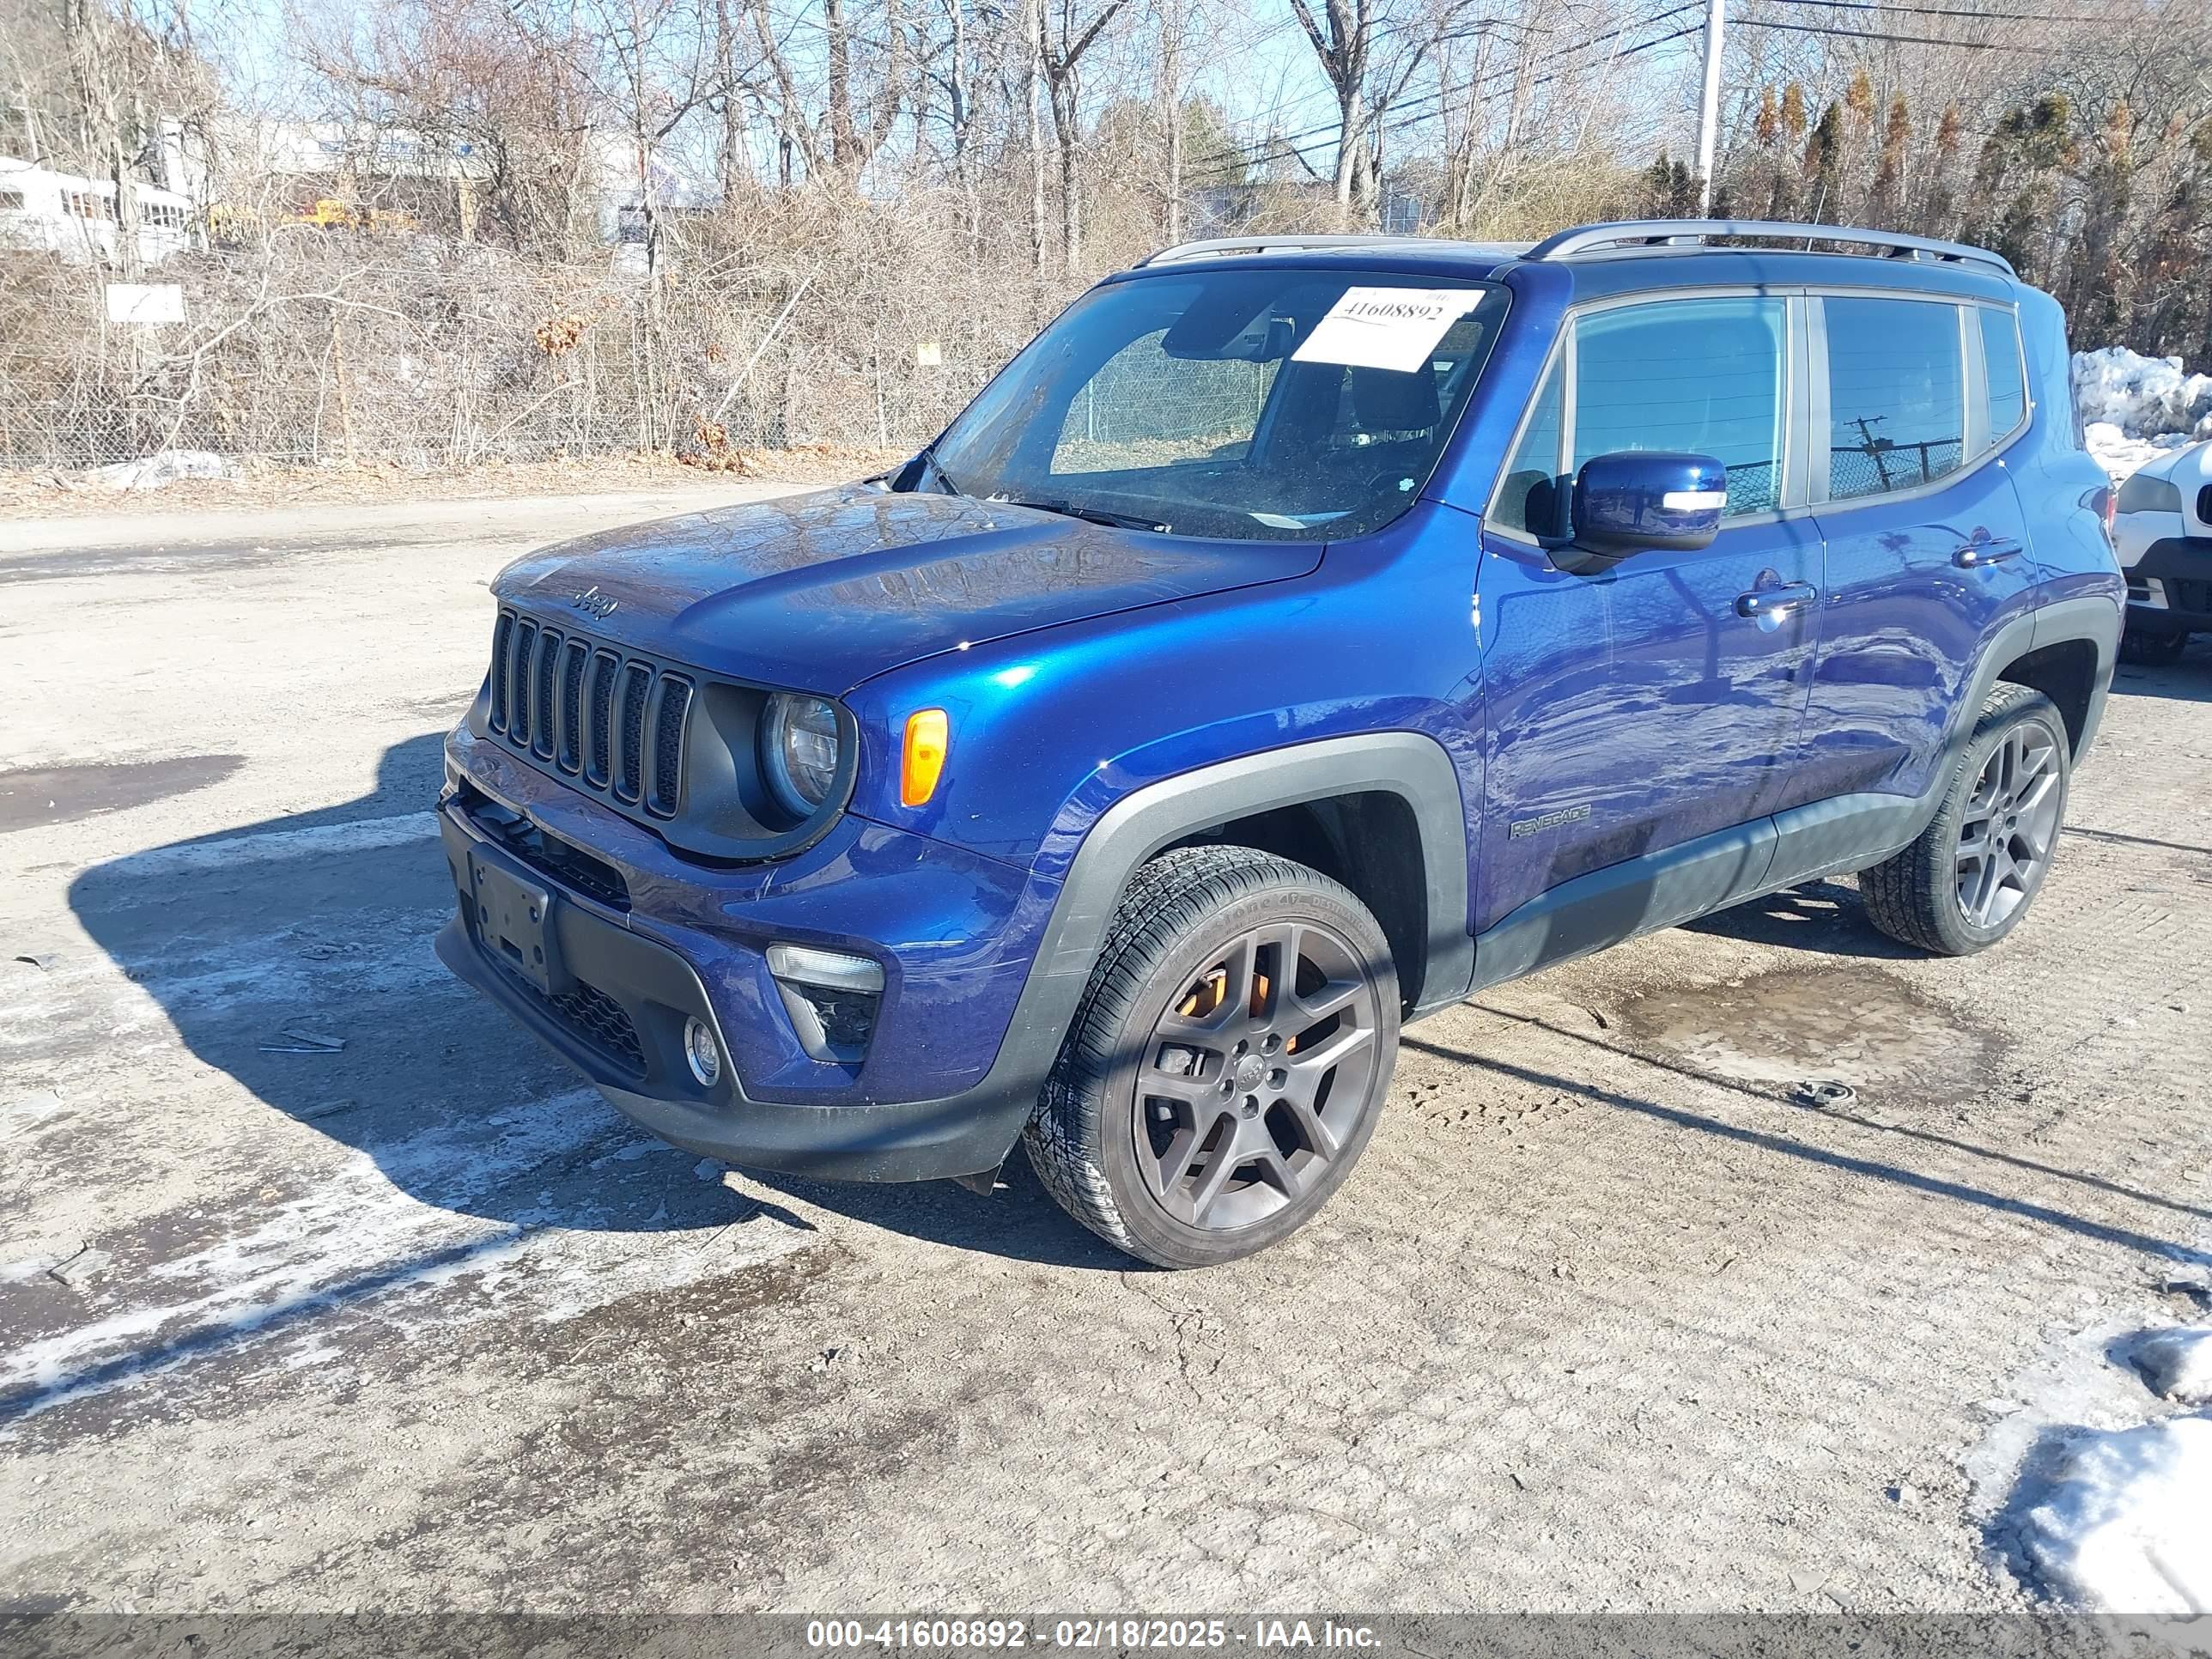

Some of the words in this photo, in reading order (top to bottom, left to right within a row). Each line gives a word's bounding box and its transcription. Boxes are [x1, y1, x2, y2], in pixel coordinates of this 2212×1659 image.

[1345, 301, 1443, 320] 41608892
[569, 586, 619, 621] Jeep
[1508, 804, 1591, 840] RENEGADE
